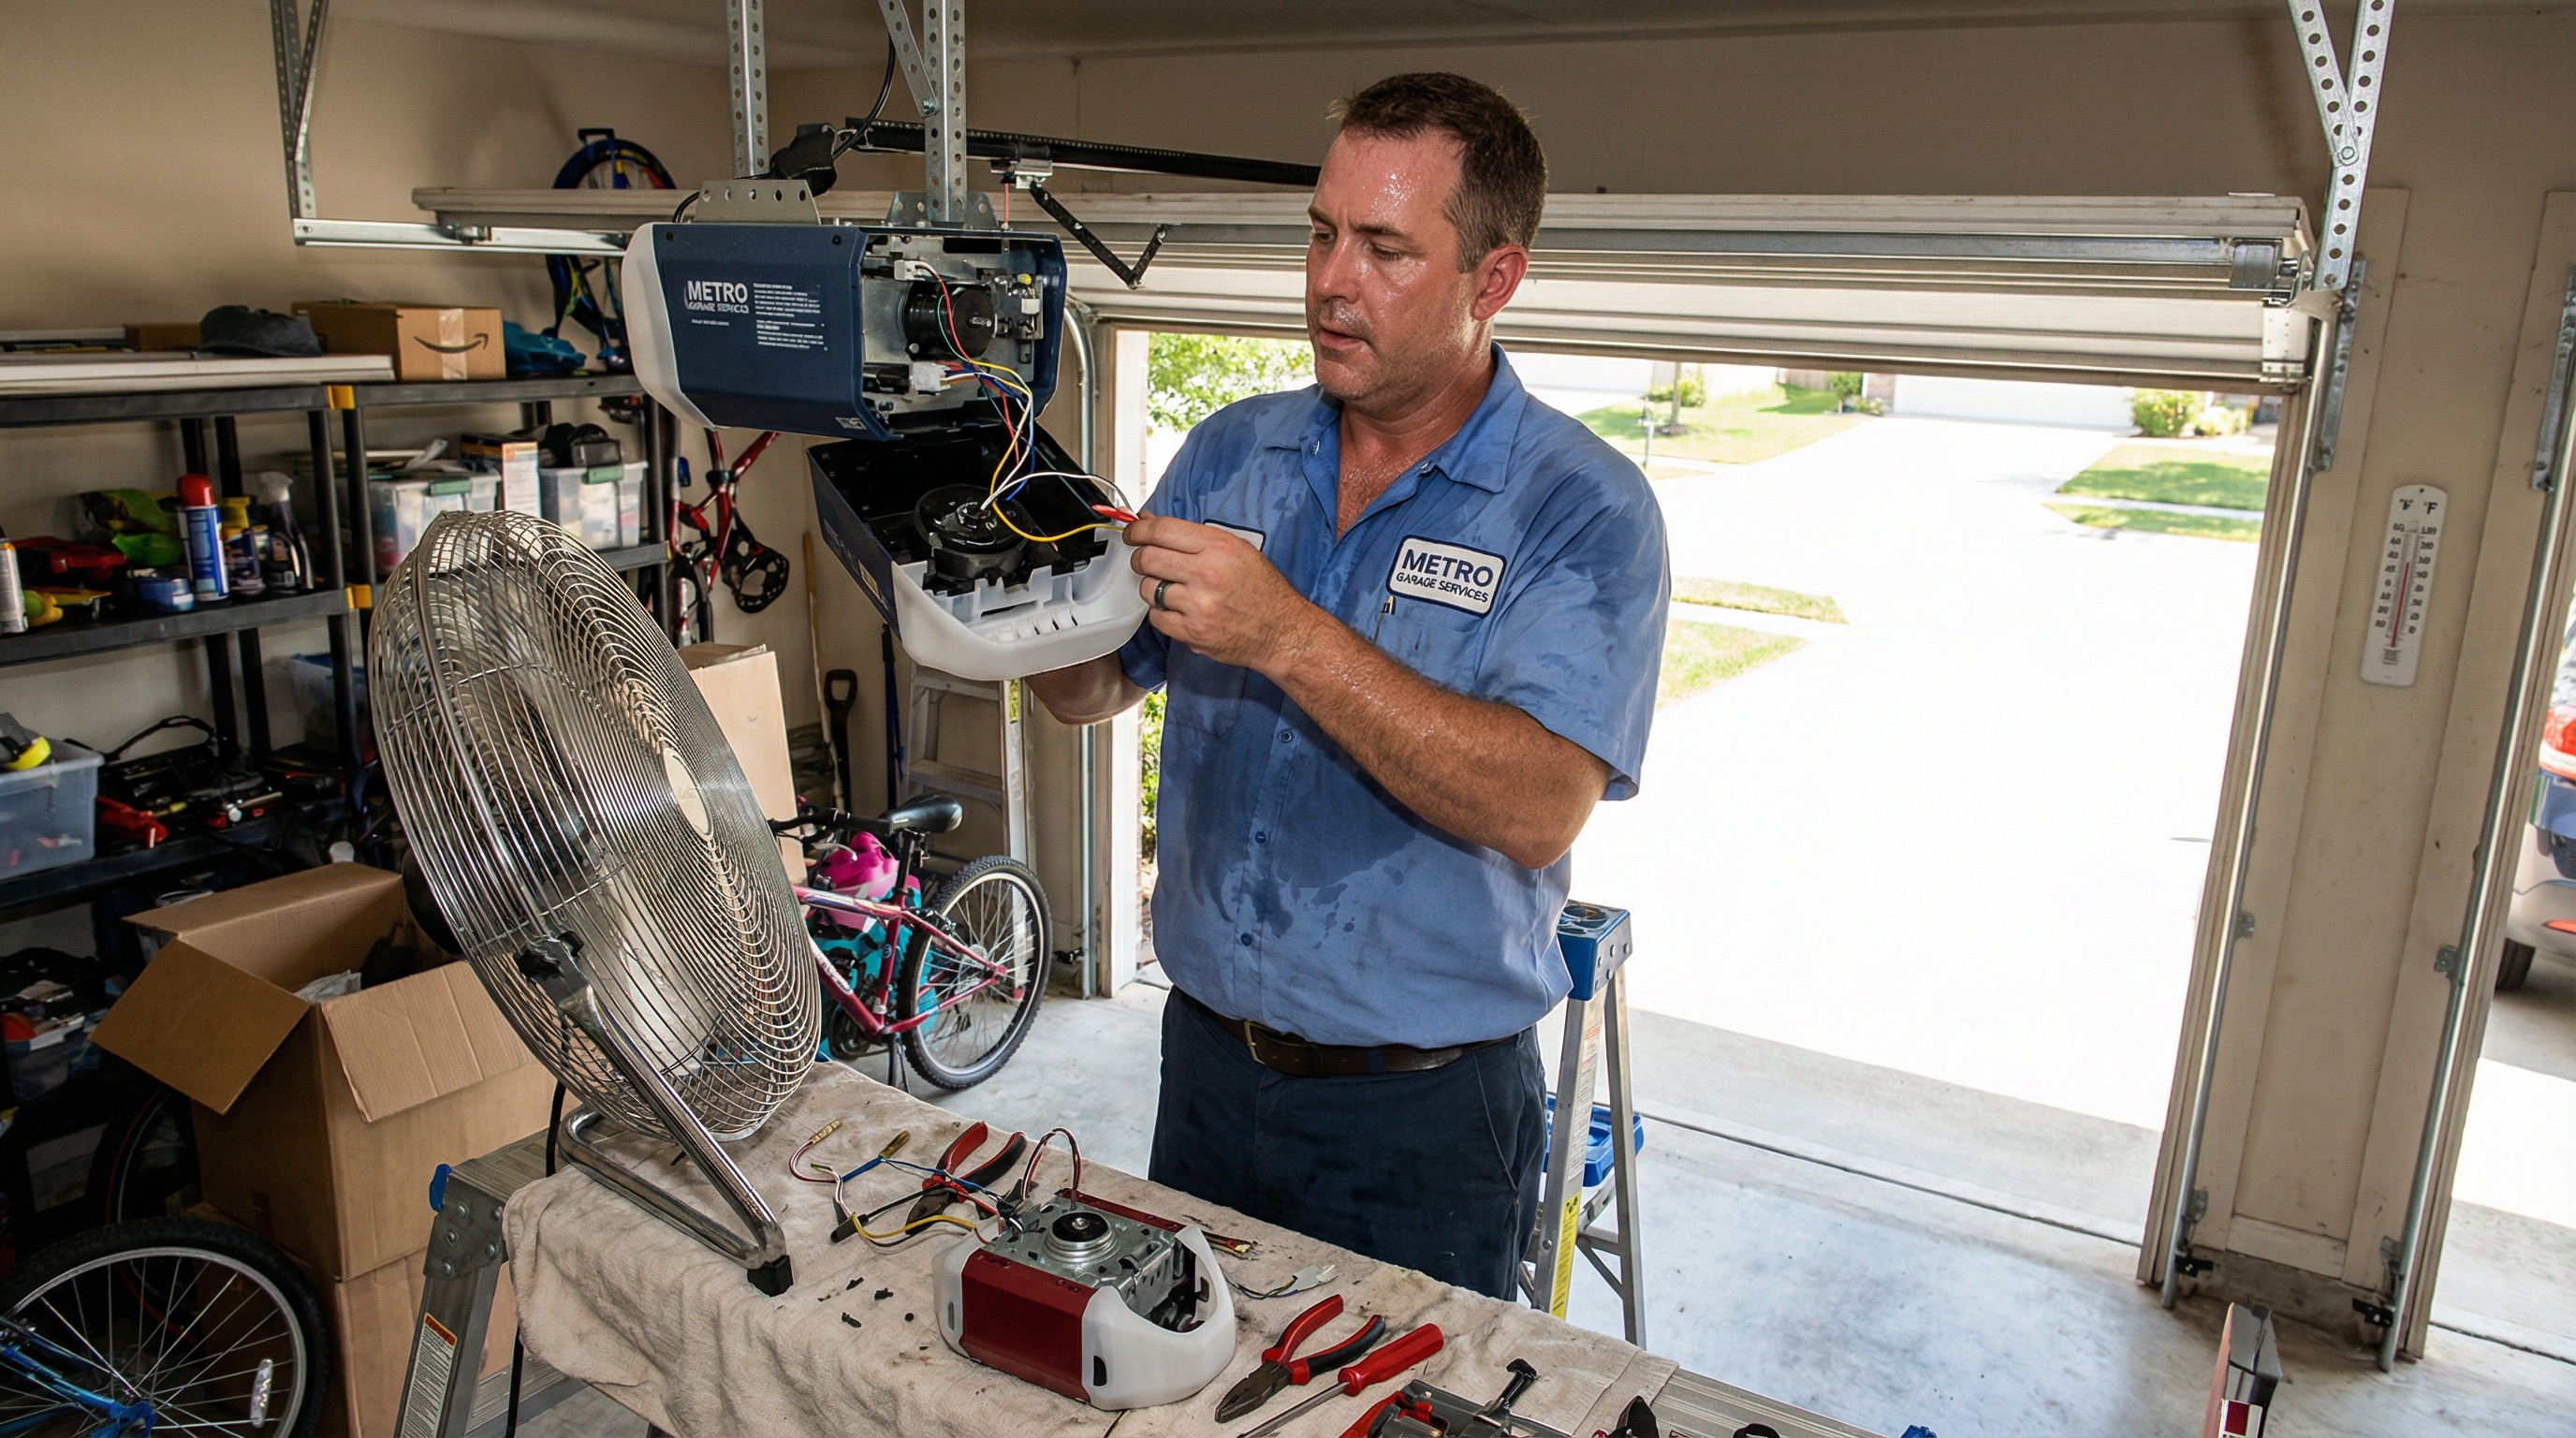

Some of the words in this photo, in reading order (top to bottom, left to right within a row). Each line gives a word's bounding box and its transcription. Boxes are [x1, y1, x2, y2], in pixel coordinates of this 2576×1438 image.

[687, 281, 748, 303] METRO
[1402, 549, 1494, 587] METRO
[1396, 572, 1437, 589] GARAGE
[1438, 580, 1489, 603] SERVICES
